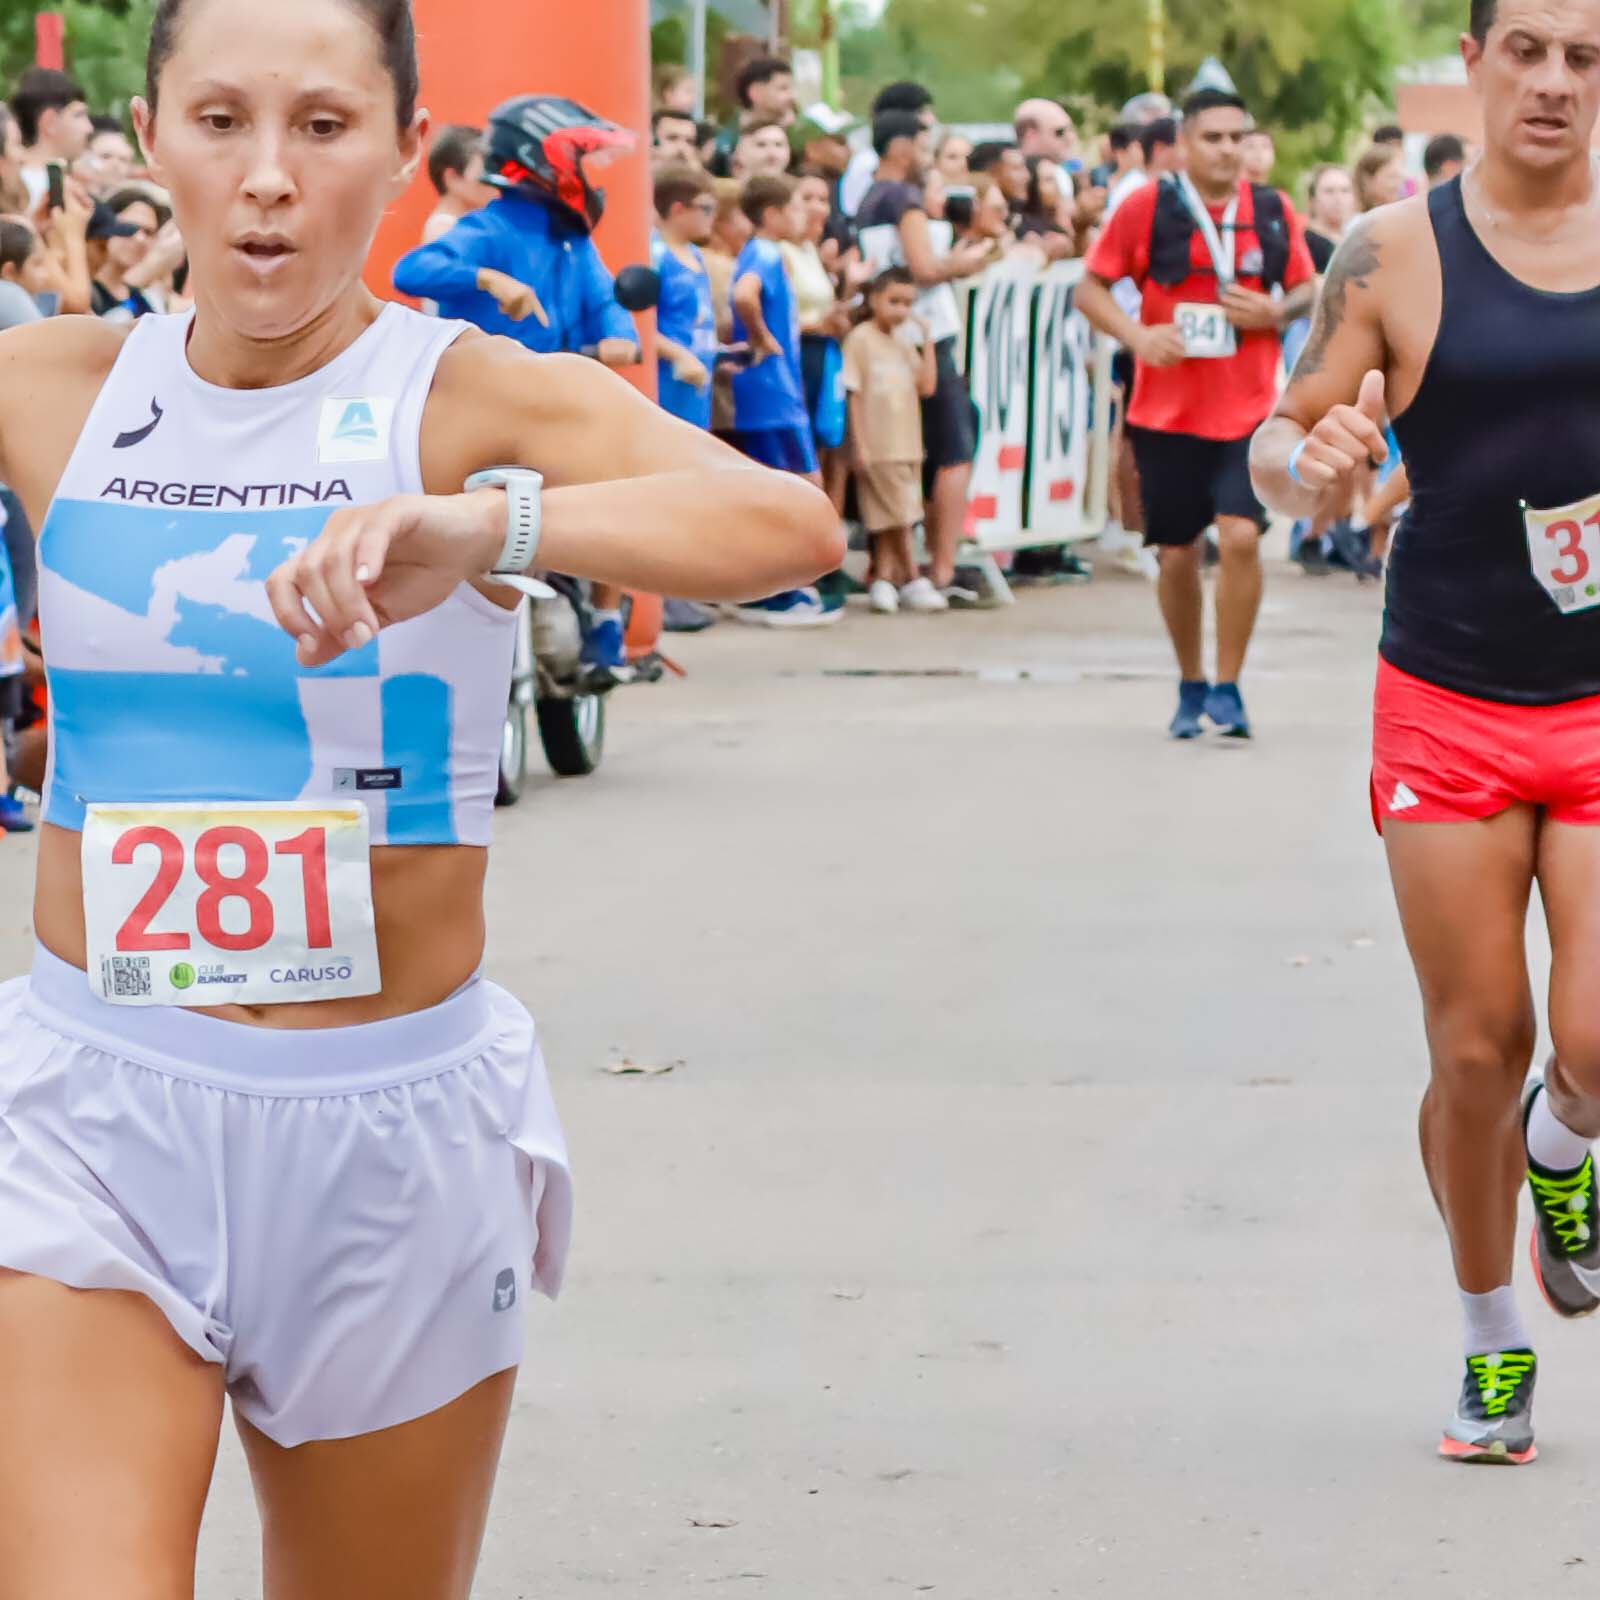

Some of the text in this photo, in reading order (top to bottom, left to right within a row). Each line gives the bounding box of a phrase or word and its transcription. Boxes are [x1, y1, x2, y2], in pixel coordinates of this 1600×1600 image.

[100, 476, 353, 507] ARGENTINA
[111, 824, 334, 952] 281
[269, 965, 352, 984] CARUSO
